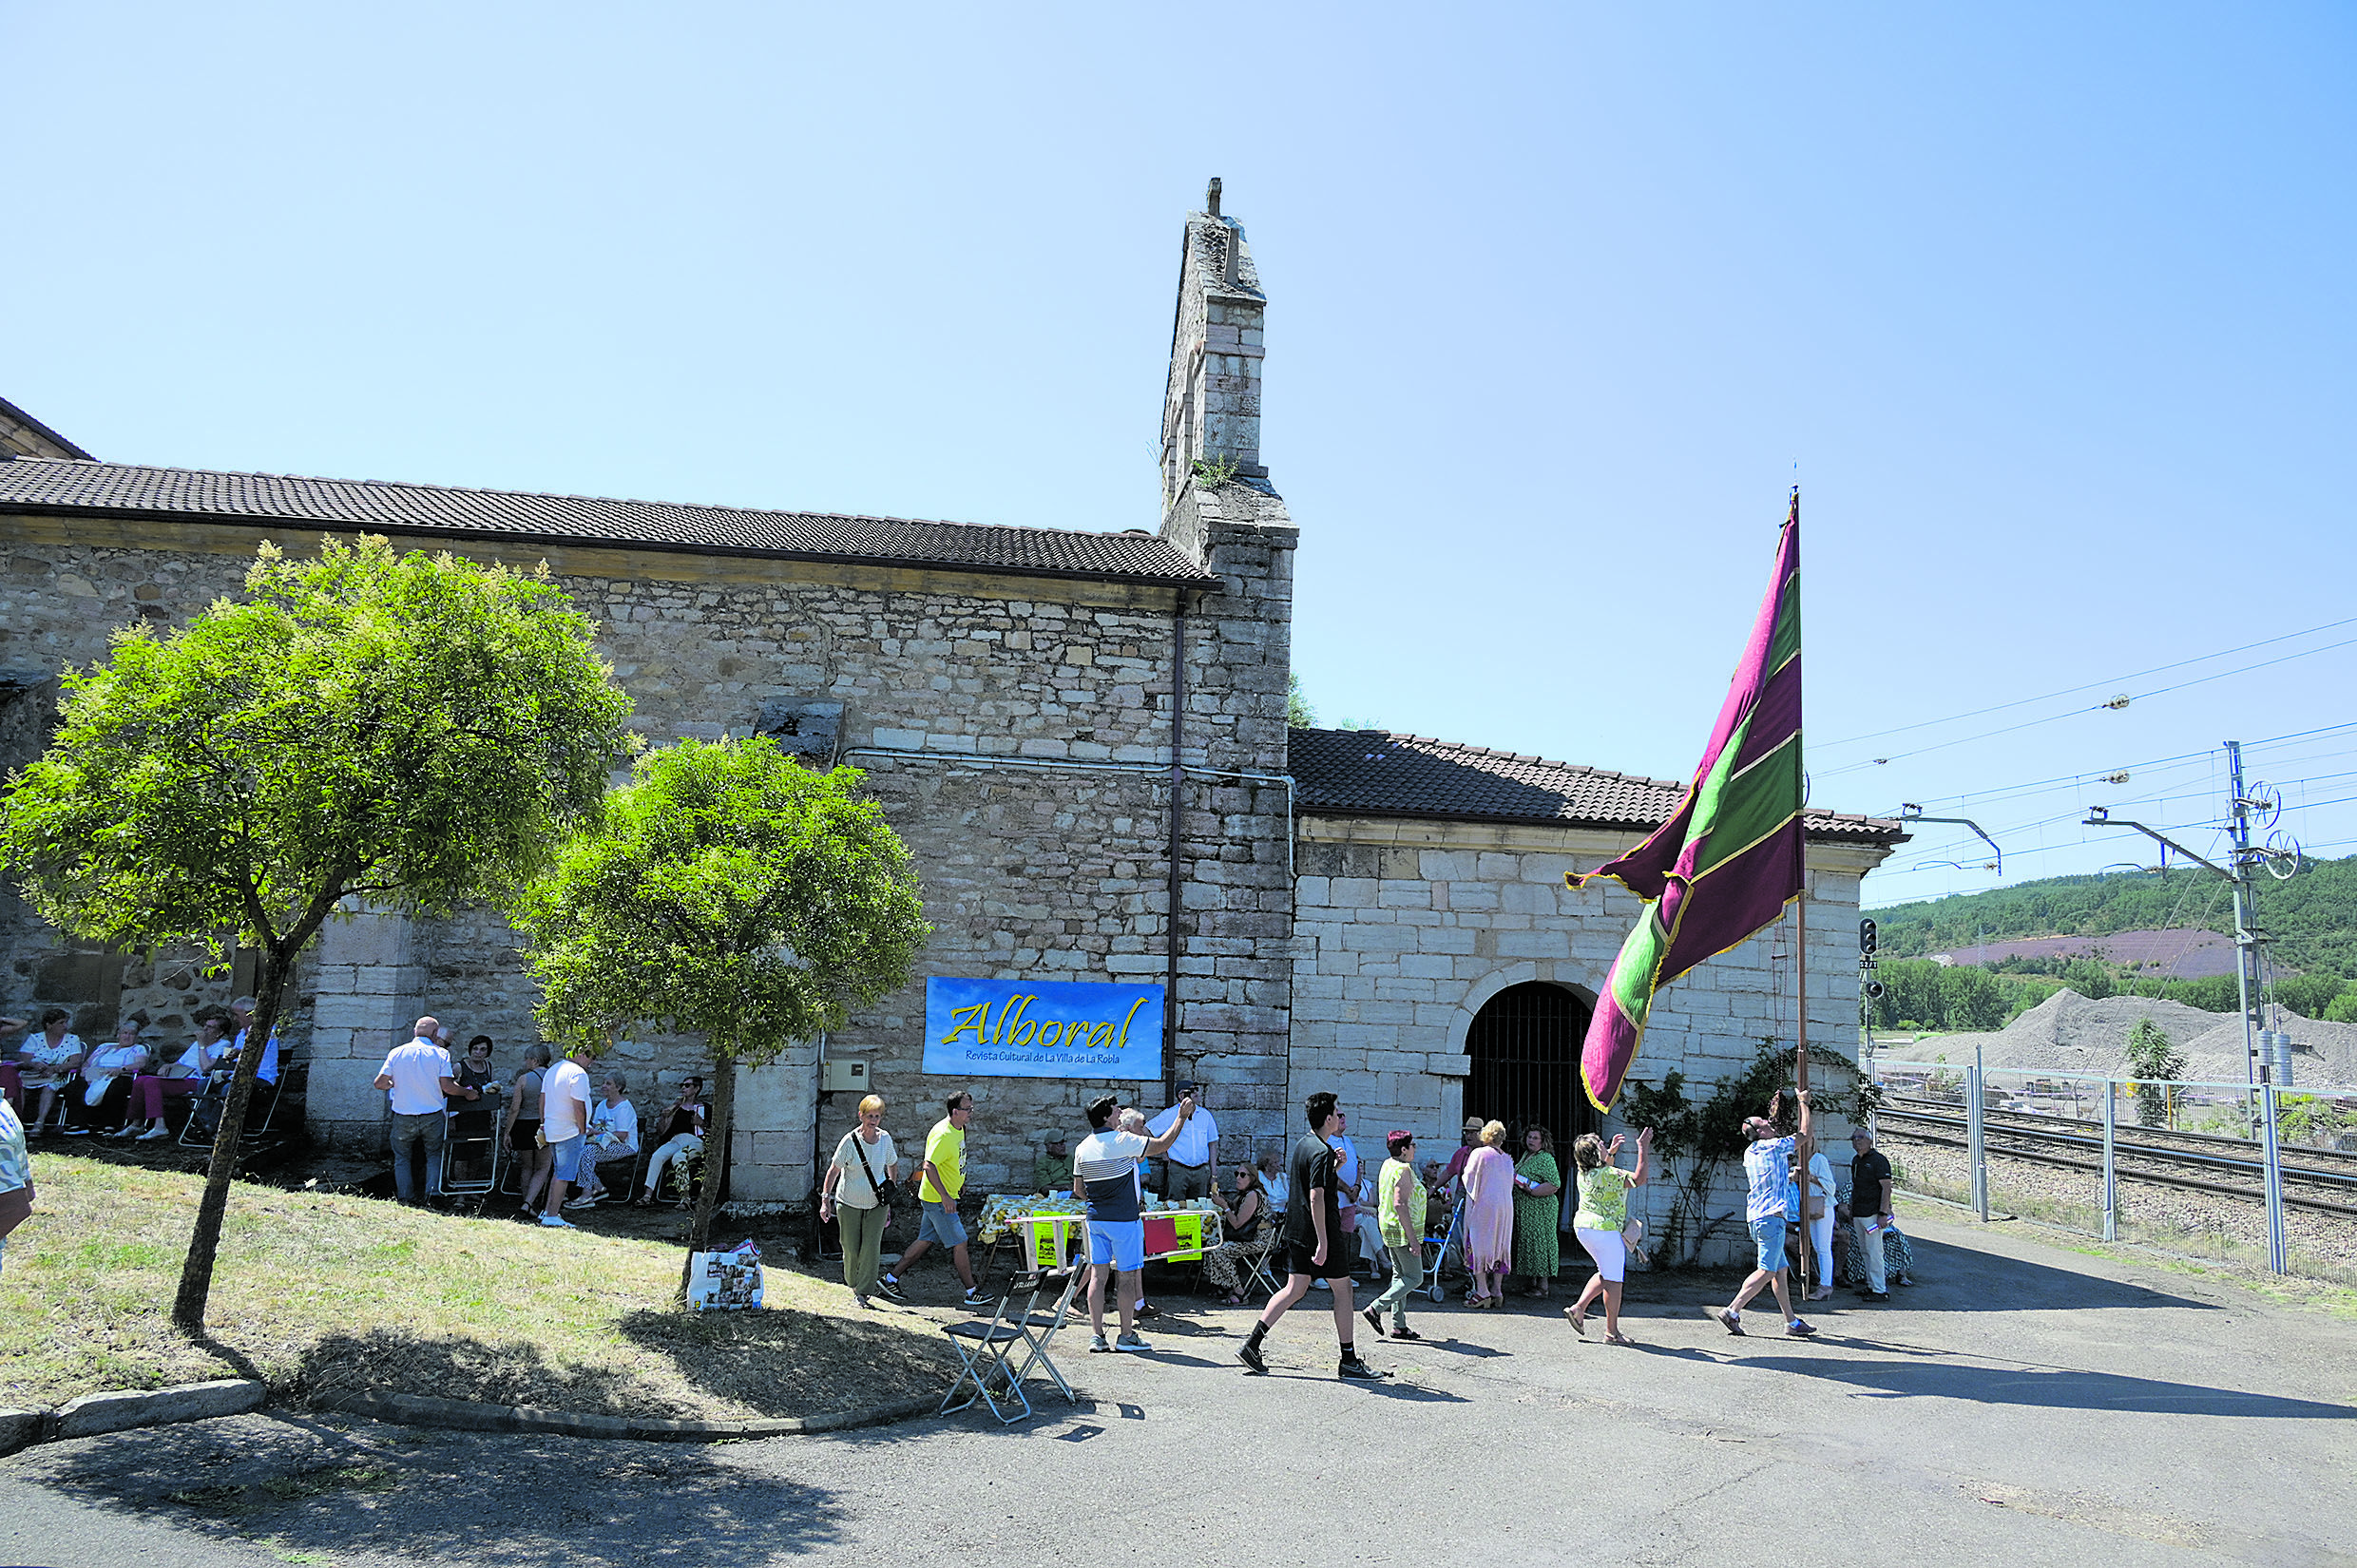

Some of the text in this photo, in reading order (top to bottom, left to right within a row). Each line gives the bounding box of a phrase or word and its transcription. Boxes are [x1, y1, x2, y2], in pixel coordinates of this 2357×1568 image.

[941, 993, 1149, 1048] Alboral
[966, 1050, 1120, 1064] Revista Cultural de La Villa de La Robla
